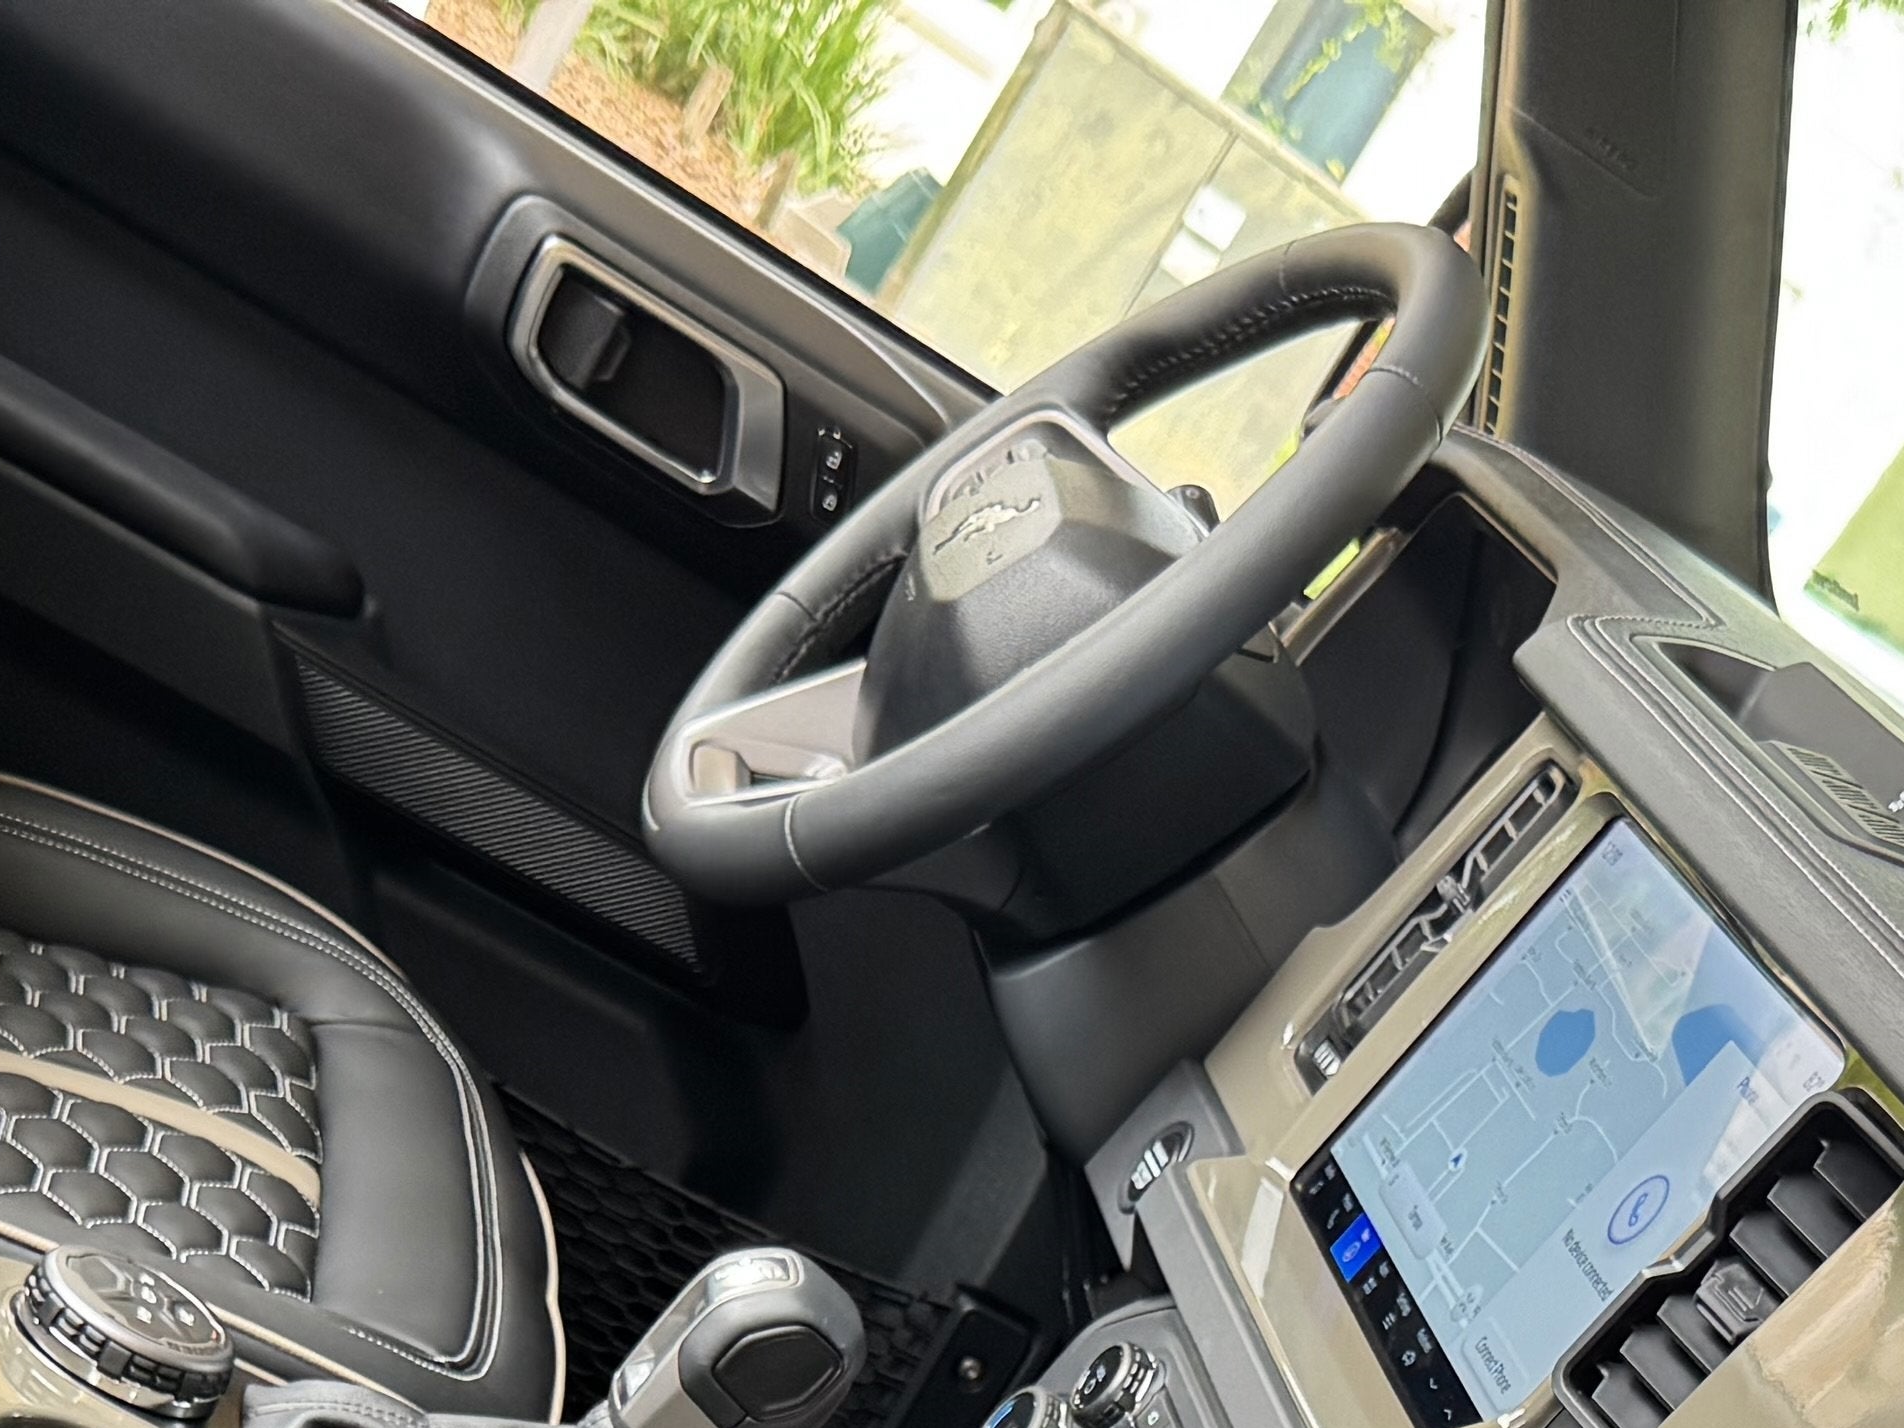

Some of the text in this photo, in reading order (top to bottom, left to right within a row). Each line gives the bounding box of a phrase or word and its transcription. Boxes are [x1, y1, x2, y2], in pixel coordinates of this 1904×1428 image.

[1568, 1241, 1589, 1268] device
[1582, 1261, 1615, 1301] connected
[1475, 1336, 1511, 1394] Connect Phone
